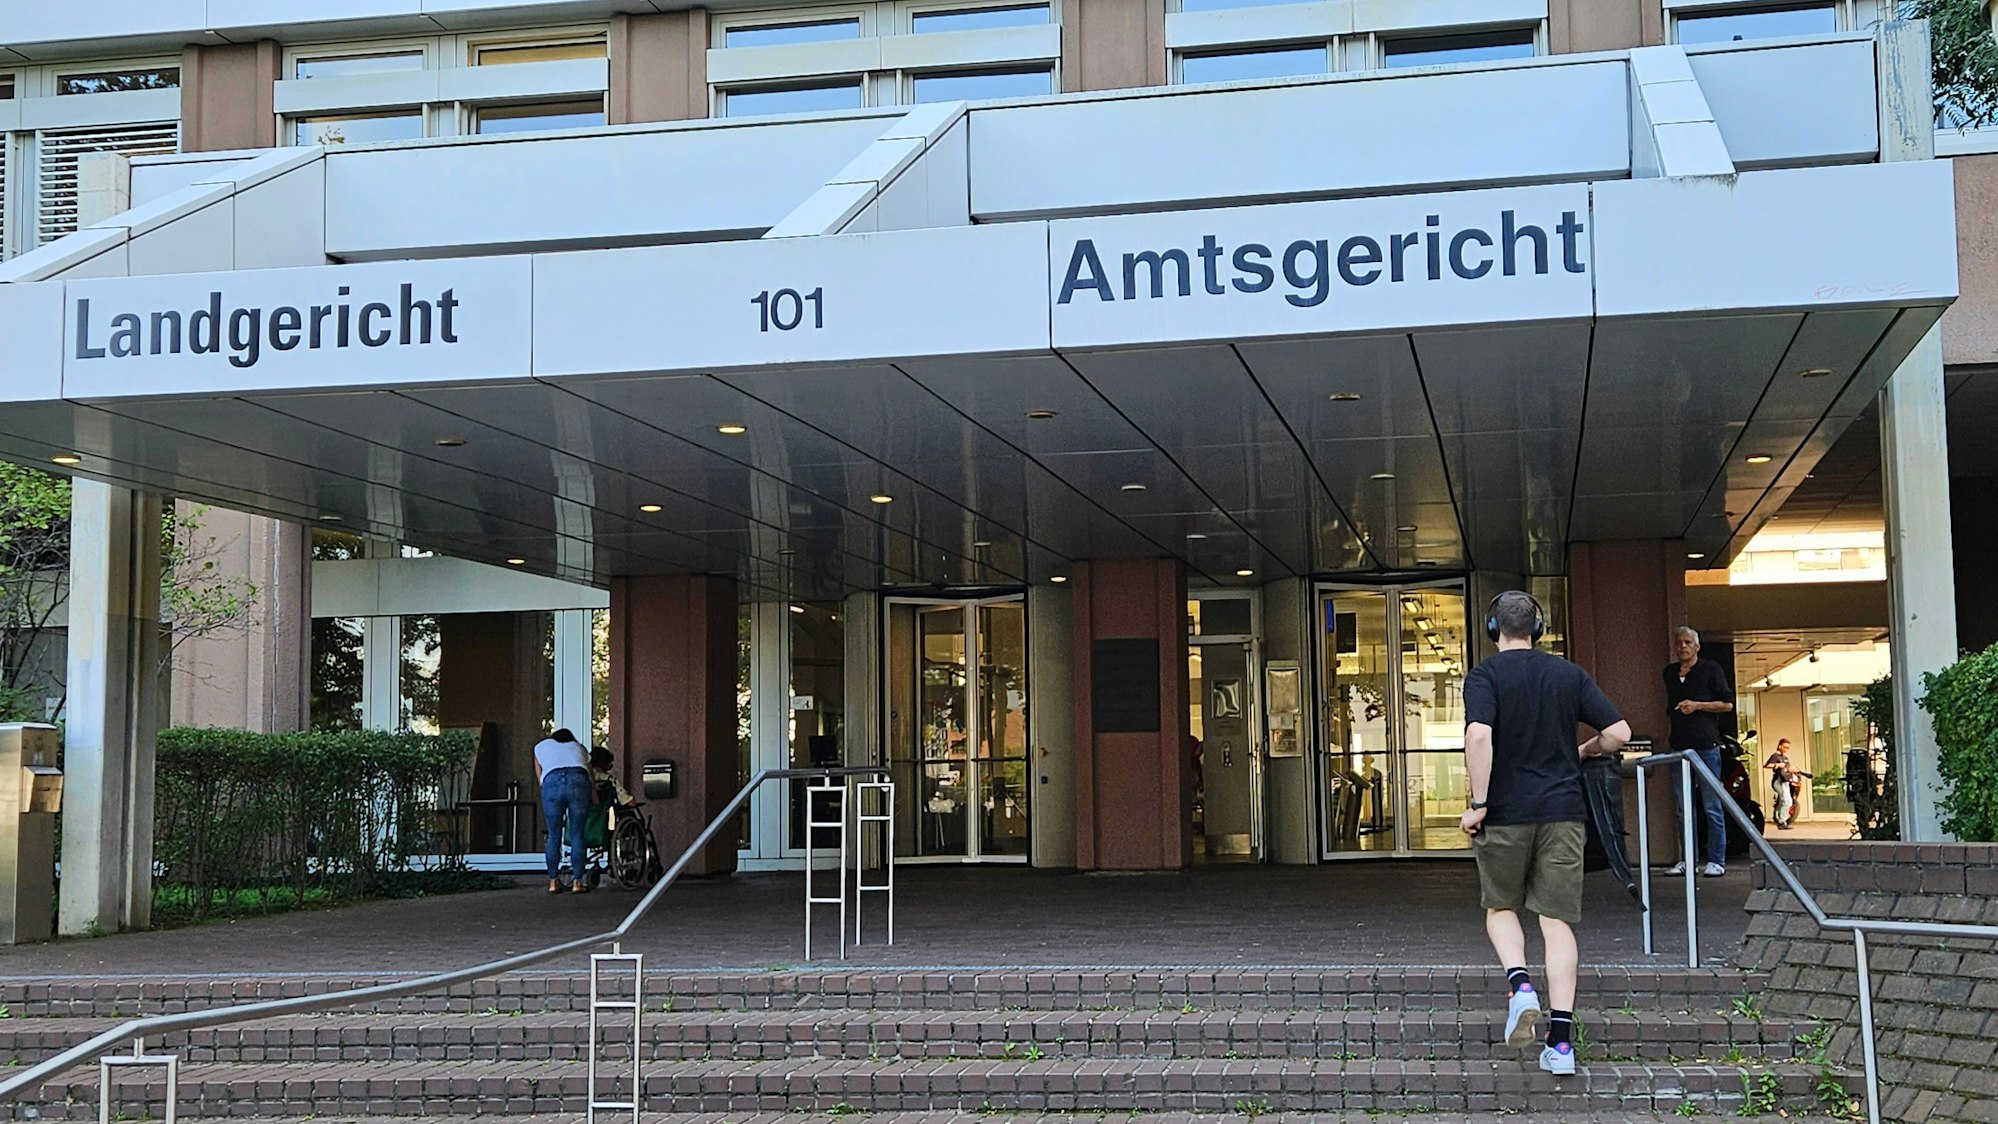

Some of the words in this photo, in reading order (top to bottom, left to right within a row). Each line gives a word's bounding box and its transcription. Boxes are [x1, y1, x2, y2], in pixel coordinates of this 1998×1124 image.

[1056, 210, 1586, 308] Amtsgericht
[76, 283, 459, 368] Landgericht
[751, 287, 823, 332] 101
